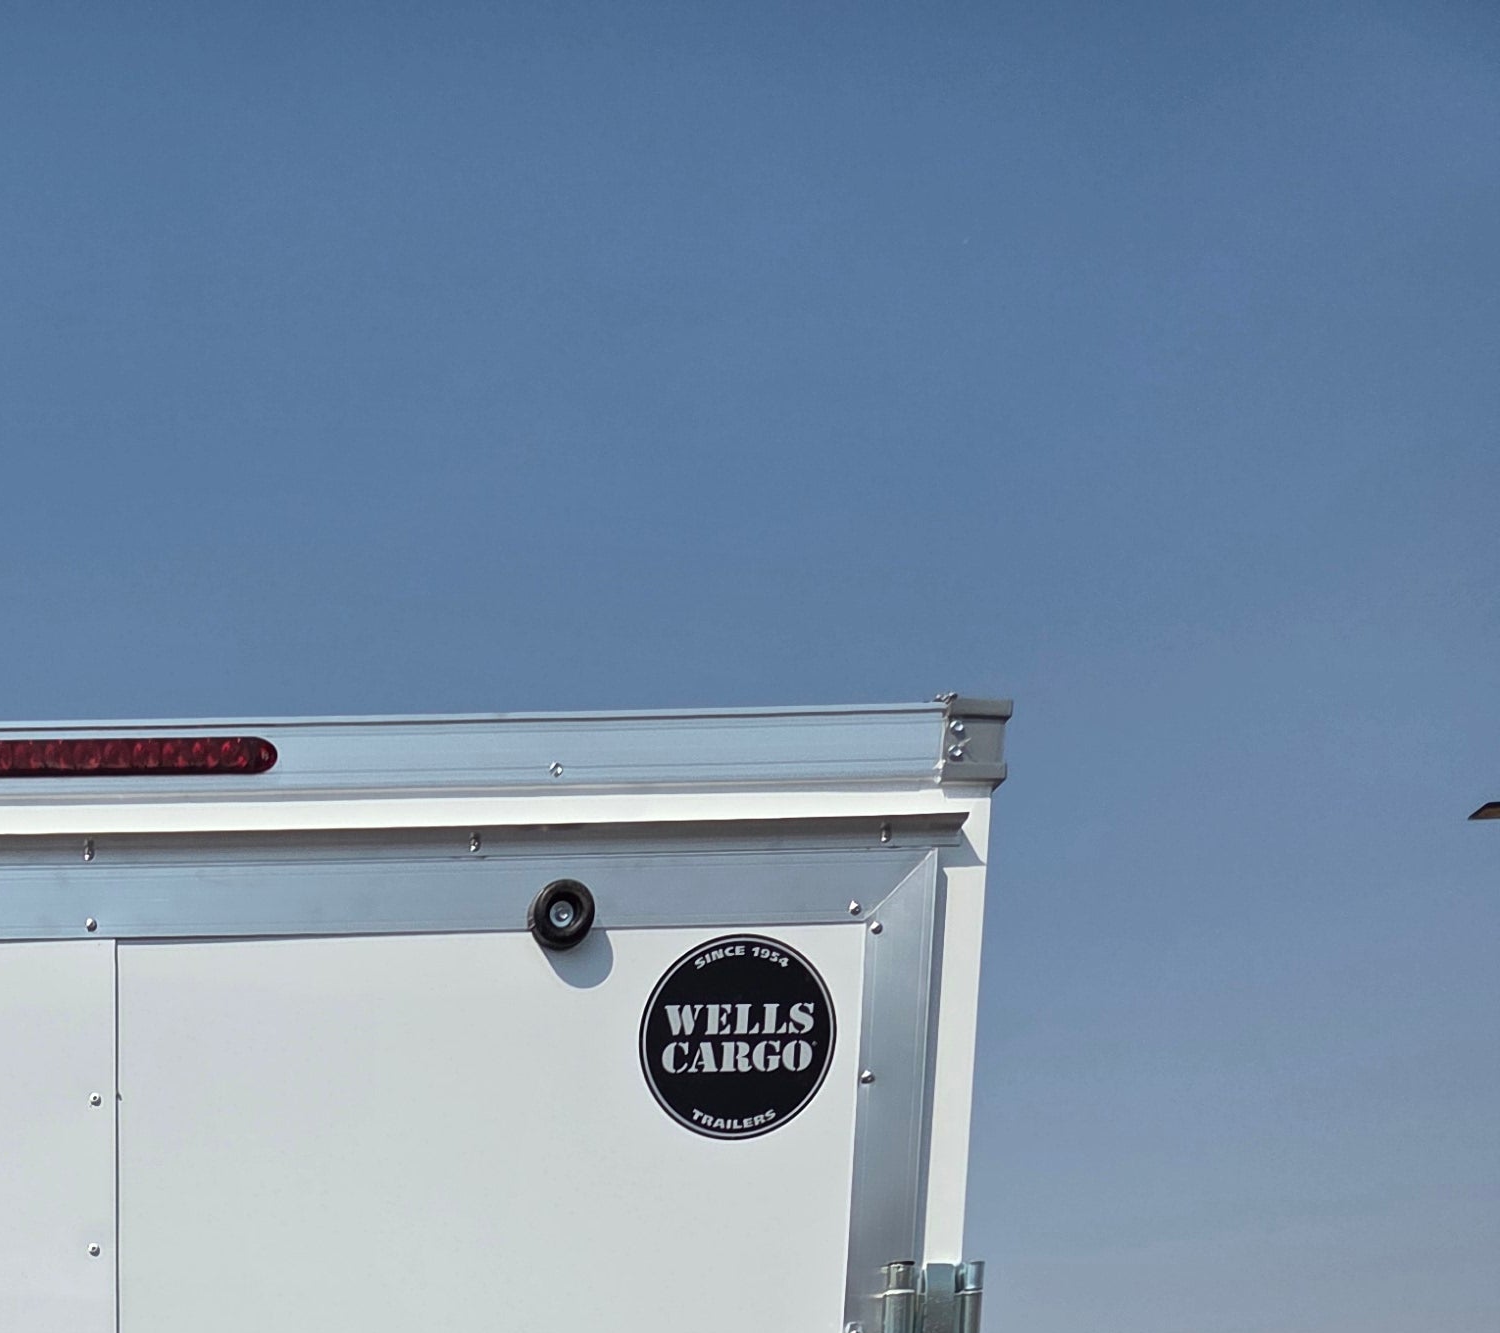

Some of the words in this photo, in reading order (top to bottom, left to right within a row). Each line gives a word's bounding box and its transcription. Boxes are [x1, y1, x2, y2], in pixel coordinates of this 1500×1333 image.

[694, 945, 746, 970] SINCE
[751, 946, 790, 968] 1954
[664, 1002, 815, 1036] WELLS
[661, 1040, 813, 1074] CARGO
[692, 1108, 777, 1130] TRAILERS
